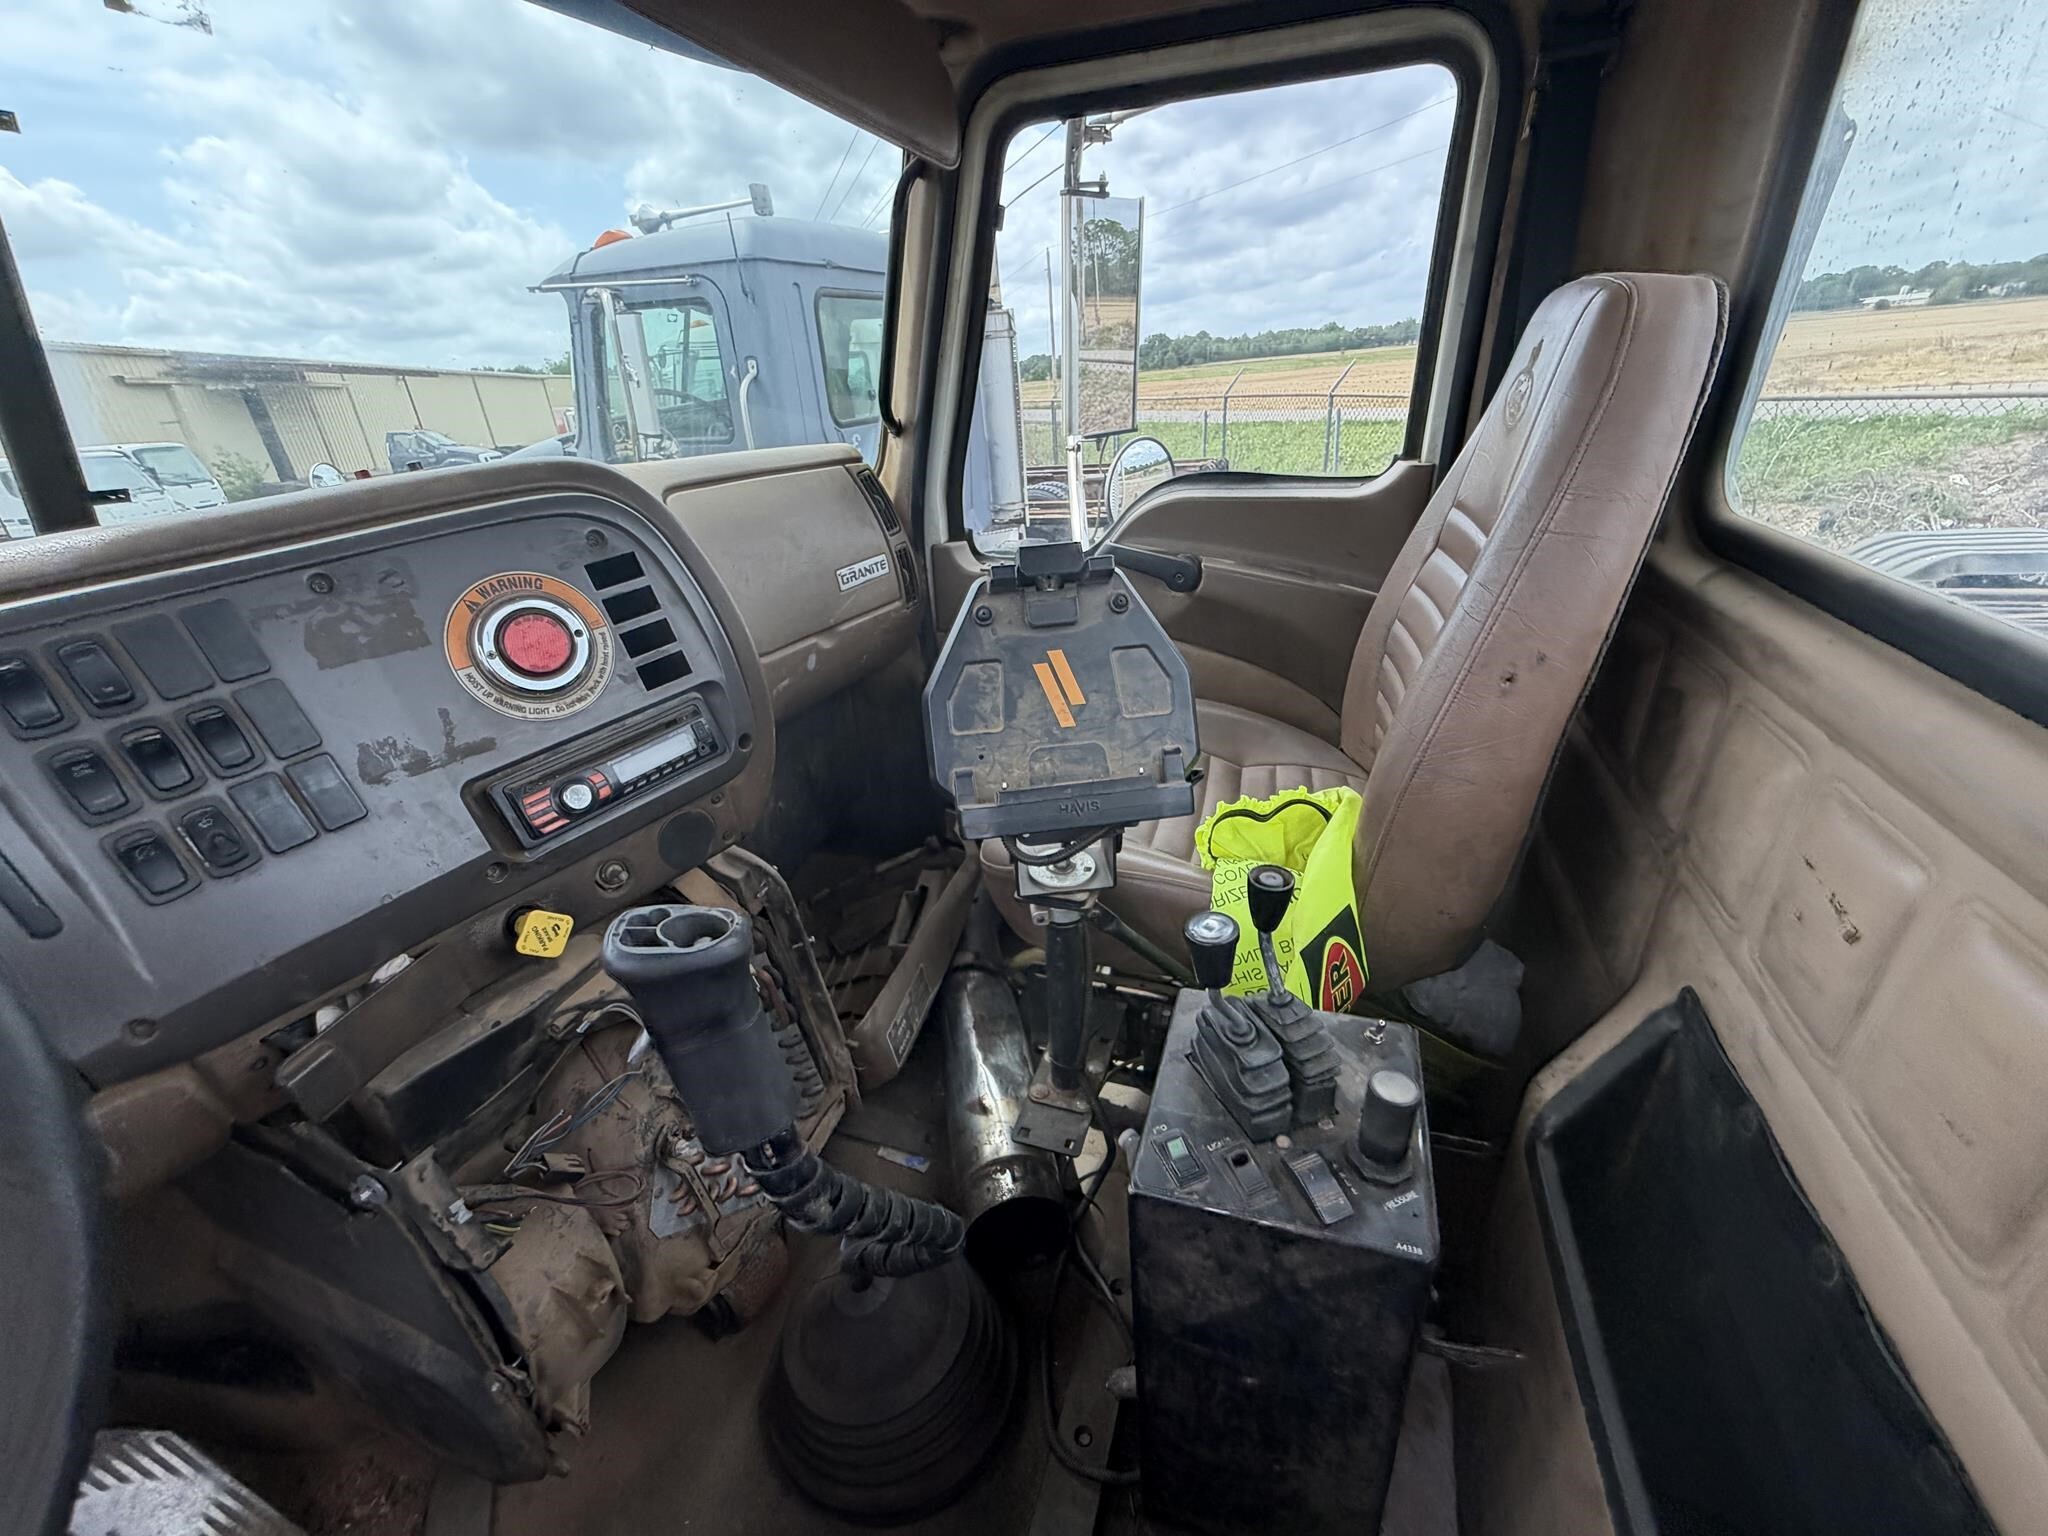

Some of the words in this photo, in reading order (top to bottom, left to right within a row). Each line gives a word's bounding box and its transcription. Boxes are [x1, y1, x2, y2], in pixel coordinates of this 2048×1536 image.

[840, 560, 887, 585] GRANITE
[475, 576, 543, 599] WARNING
[464, 672, 484, 691] HOIST
[482, 689, 494, 699] UP
[494, 696, 526, 713] WARNING
[528, 707, 550, 715] LIGHT
[555, 703, 566, 712] Do
[1059, 800, 1100, 817] HAVIS
[532, 925, 549, 951] PARKING
[541, 927, 553, 943] BRAKE
[1329, 947, 1354, 1012] ER
